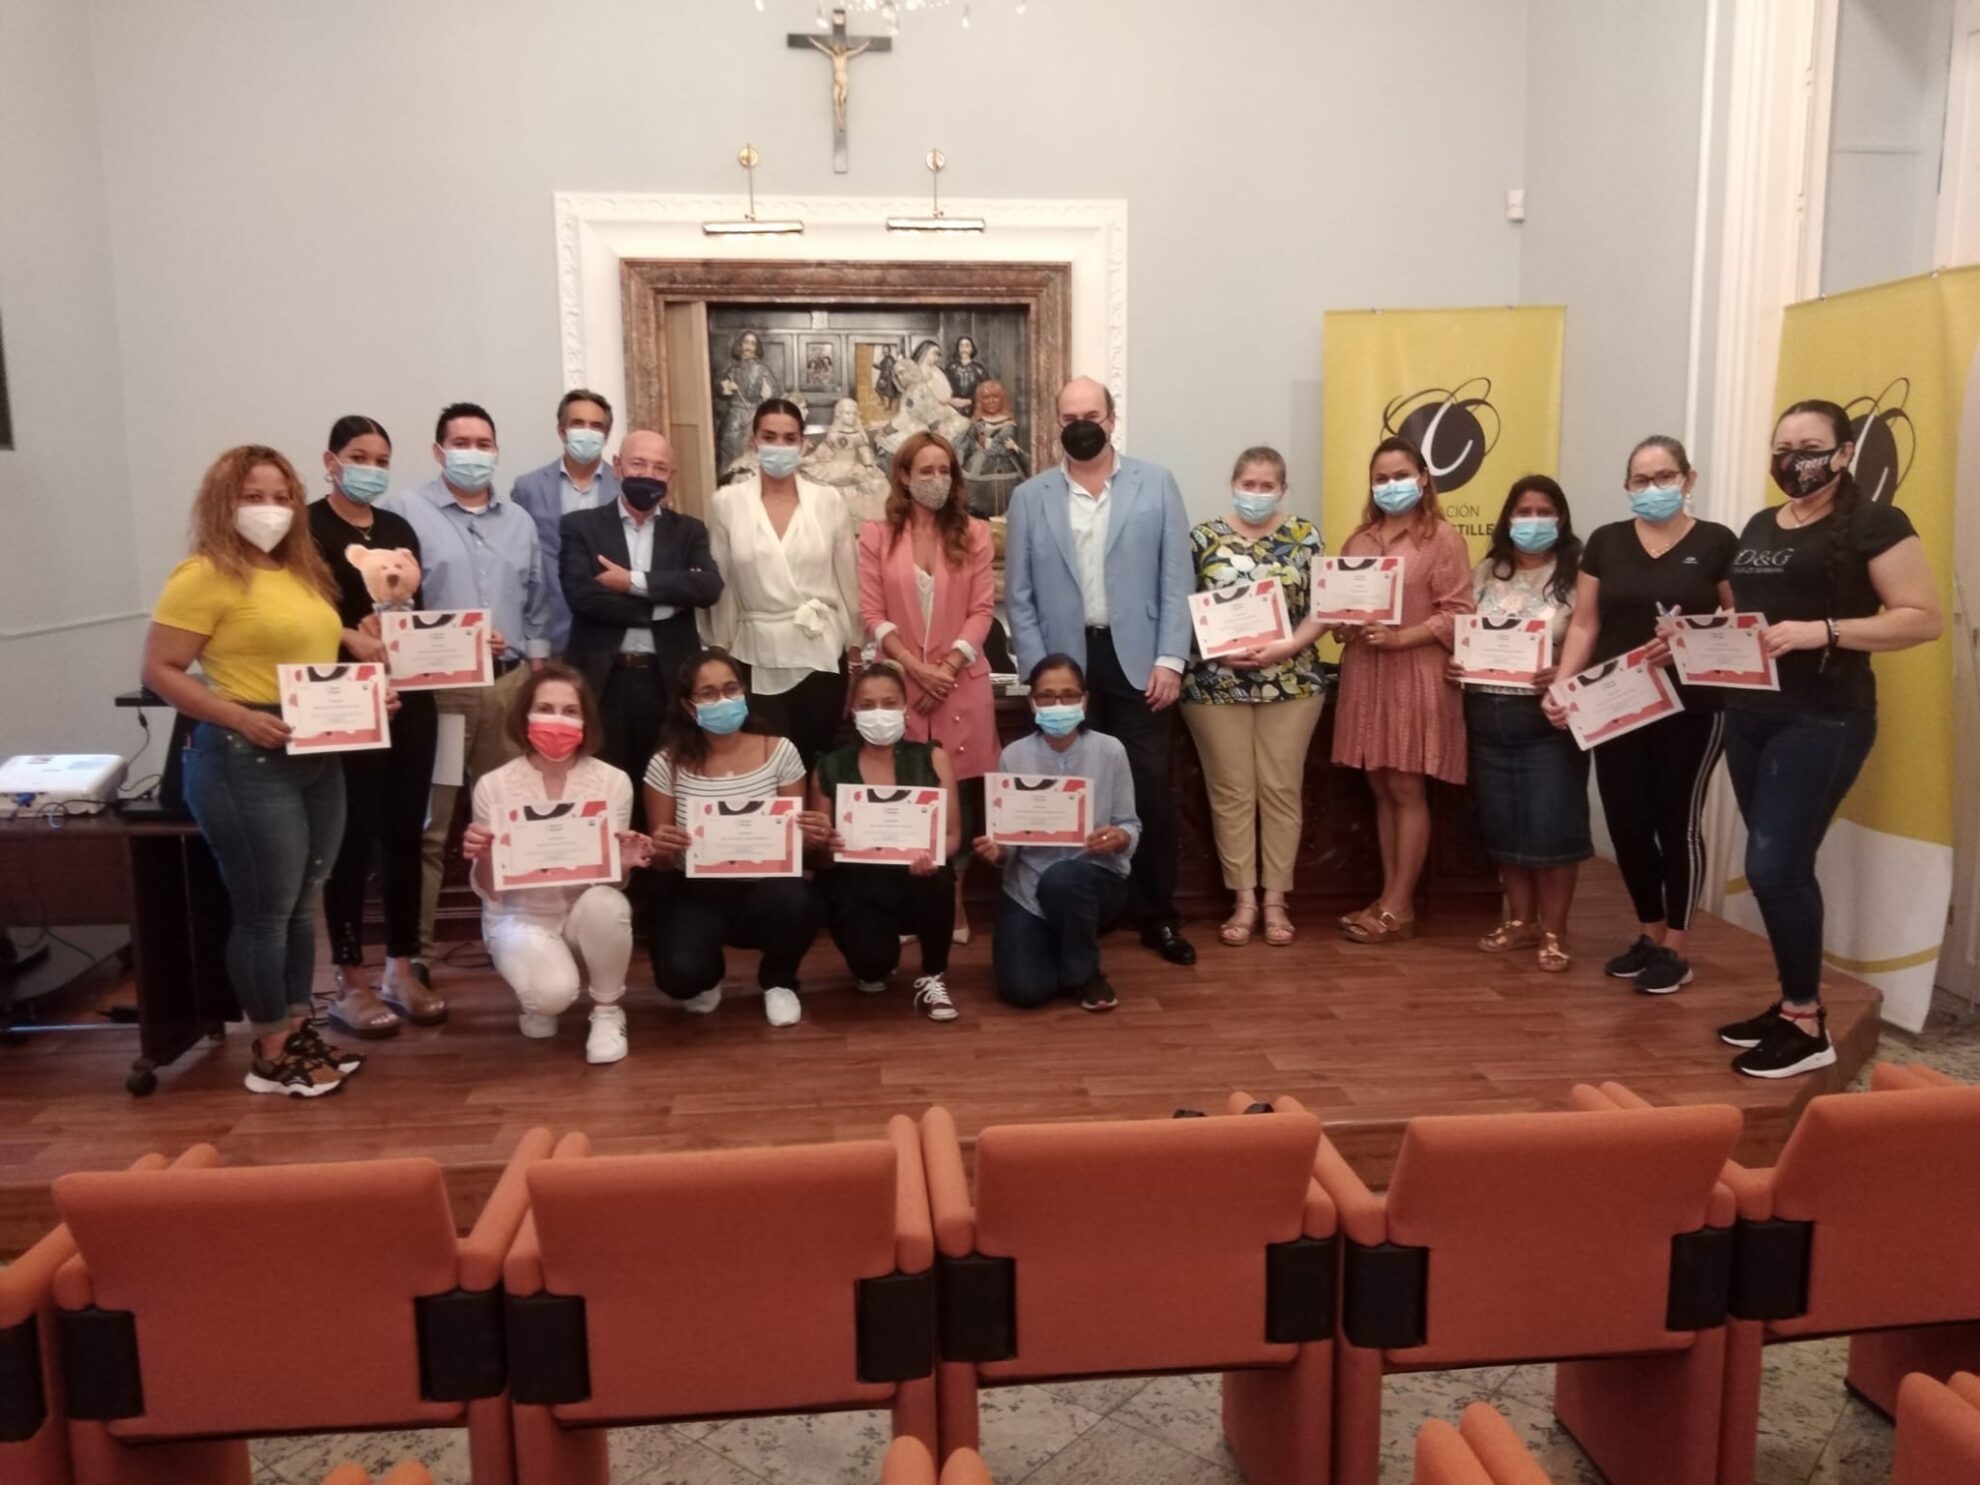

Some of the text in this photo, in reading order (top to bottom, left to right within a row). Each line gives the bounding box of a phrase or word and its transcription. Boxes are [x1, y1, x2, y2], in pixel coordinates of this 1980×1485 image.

[1446, 502, 1480, 519] CIÓN
[1456, 523, 1496, 537] TILLE
[1733, 548, 1795, 567] D&G
